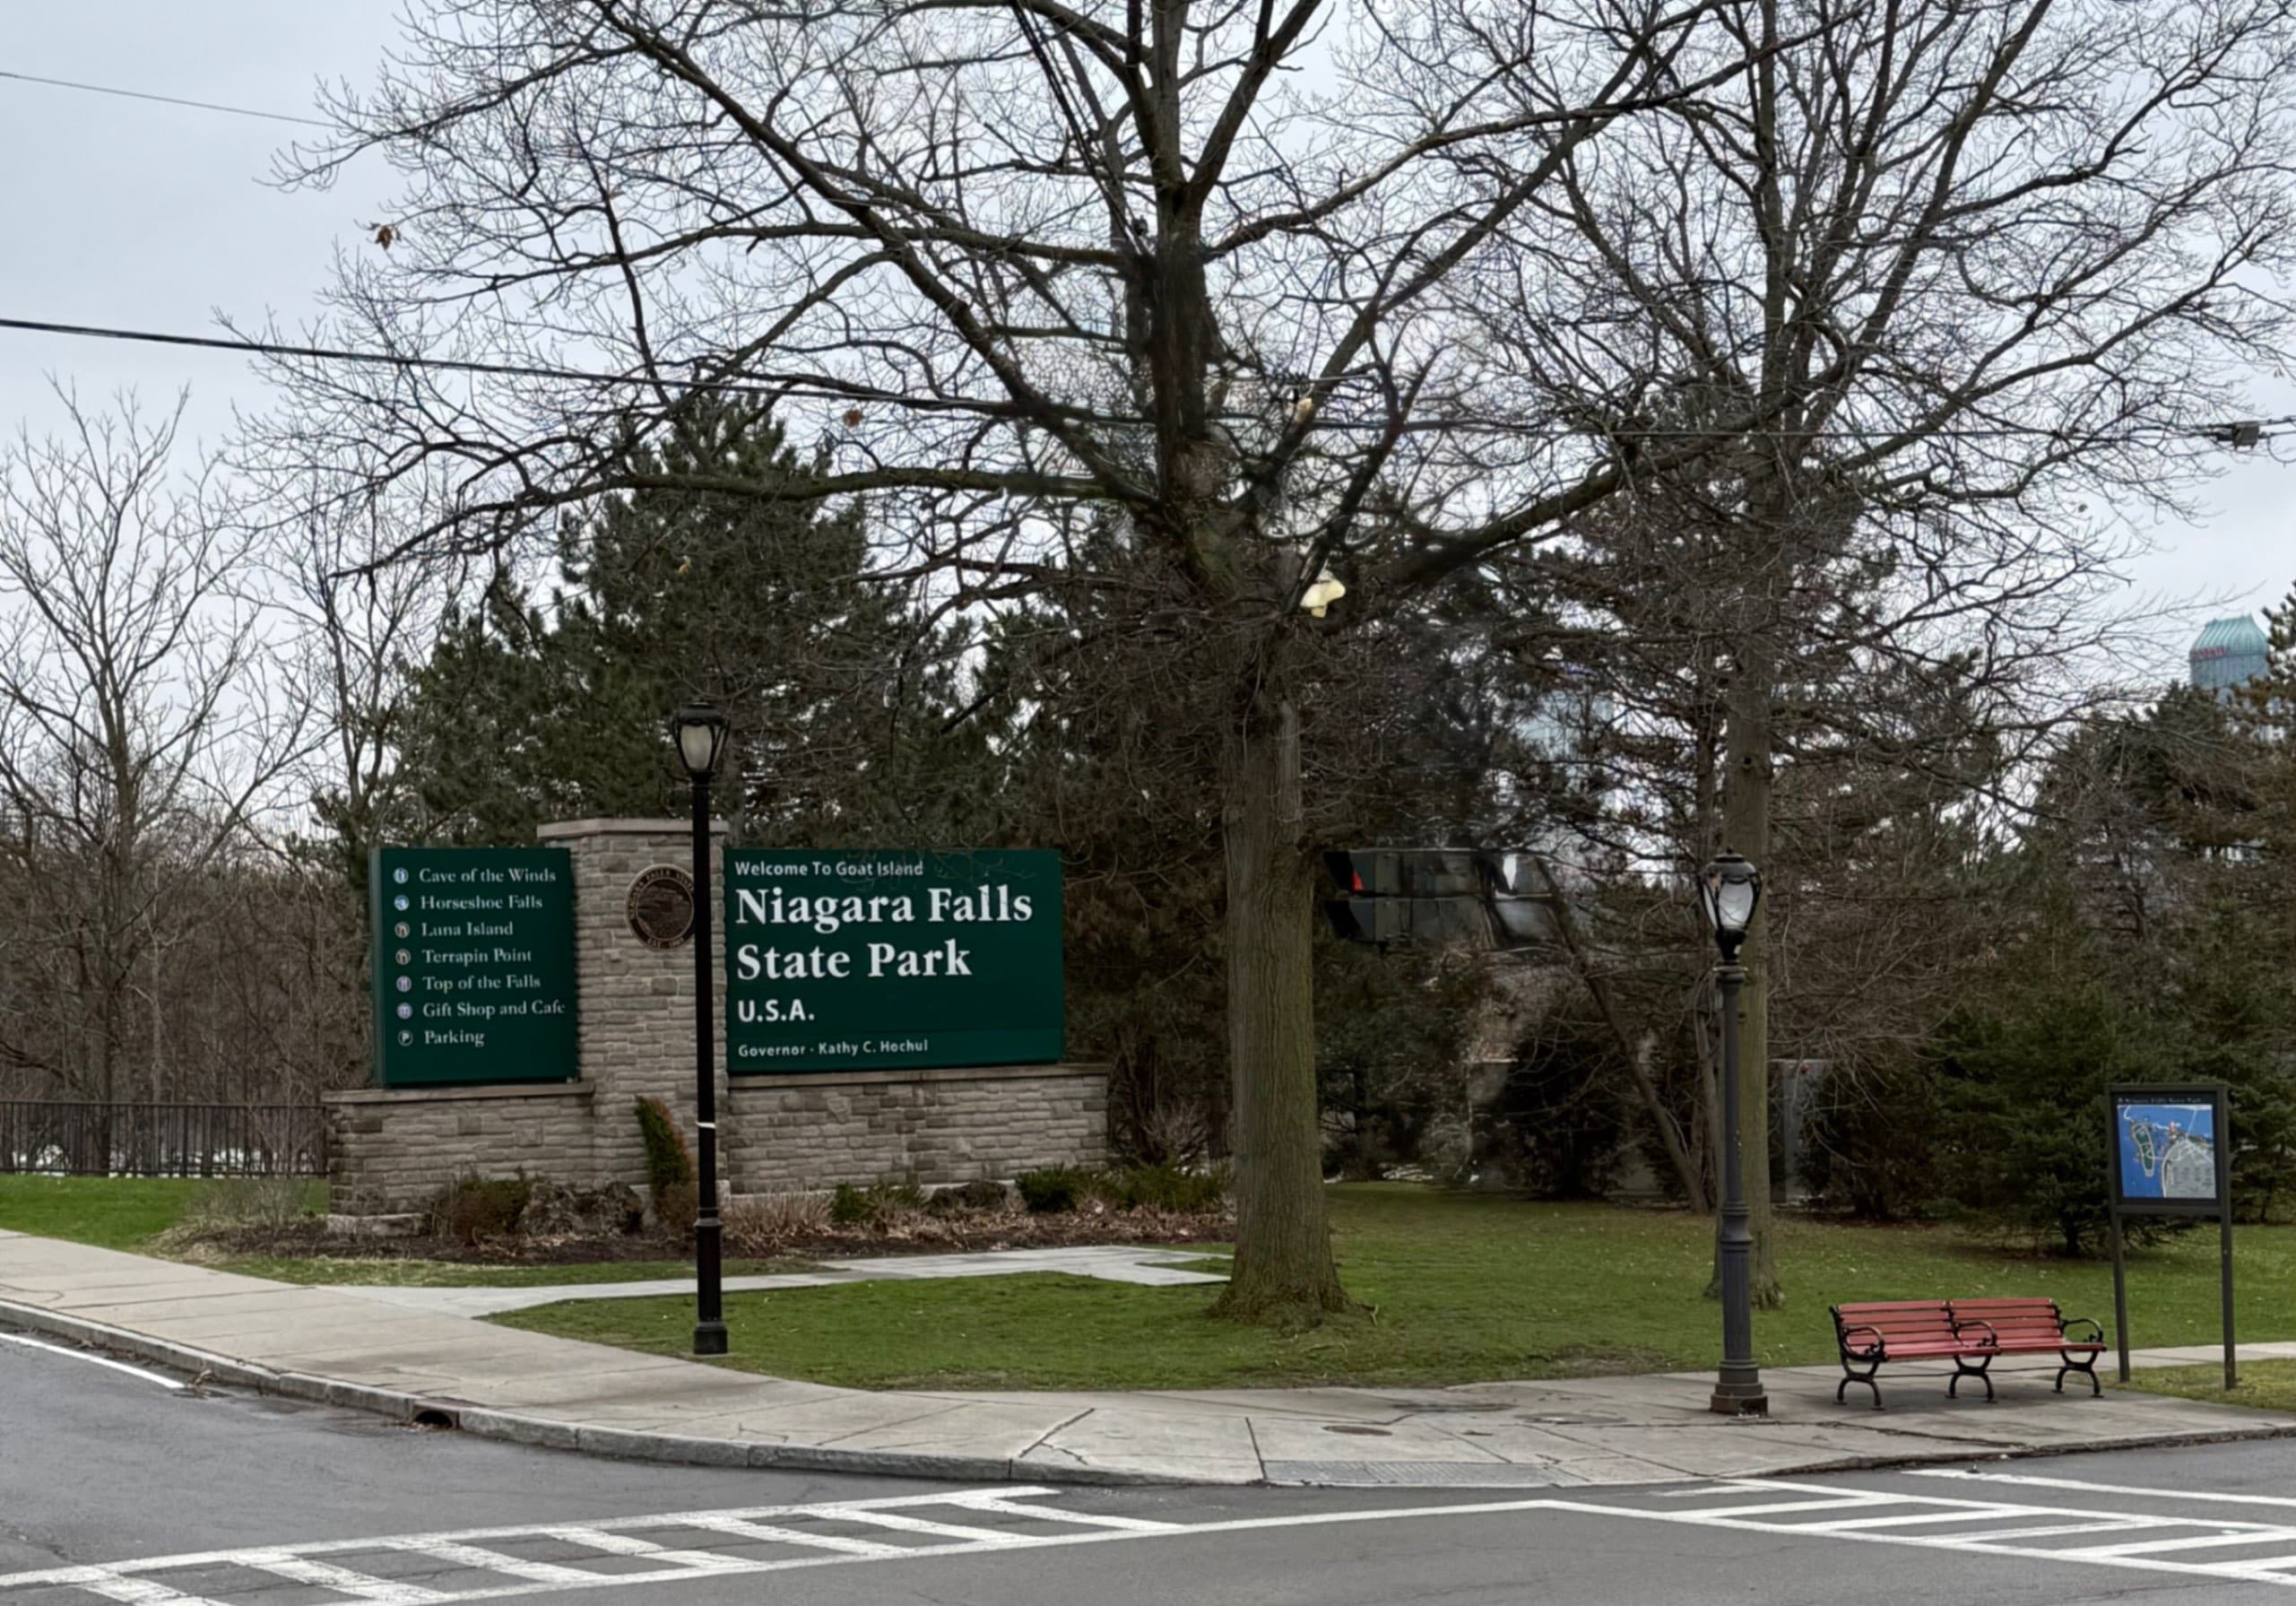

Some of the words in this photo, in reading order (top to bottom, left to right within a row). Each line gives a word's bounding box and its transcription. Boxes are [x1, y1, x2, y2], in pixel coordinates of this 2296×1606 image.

[419, 868, 456, 882] Cave
[461, 868, 478, 882] of
[480, 868, 504, 882] the
[507, 867, 557, 882] Winds
[735, 861, 808, 876] Welcome
[812, 861, 832, 876] To
[836, 861, 873, 876] Goat
[877, 860, 924, 876] Island
[420, 896, 503, 909] Horseshoe
[508, 895, 543, 909] Falls
[735, 887, 915, 934] Niagara
[927, 884, 1033, 922] Falls
[421, 923, 461, 936] Luna
[467, 922, 514, 936] Island
[422, 950, 489, 967] Terrapin
[493, 948, 533, 962] Point
[737, 943, 851, 980] State
[867, 938, 973, 977] Park
[422, 977, 454, 994] Top
[458, 975, 475, 989] of
[478, 976, 502, 989] the
[506, 975, 542, 989] Falls
[422, 1003, 452, 1017] Gift
[456, 1002, 496, 1020] Shop
[499, 1001, 527, 1015] and
[738, 999, 815, 1022] U.S.A.
[424, 1029, 485, 1047] Parking
[738, 1045, 806, 1057] Governor
[819, 1041, 859, 1055] Kathy
[862, 1040, 876, 1054] C.
[880, 1039, 928, 1053] Hochul
